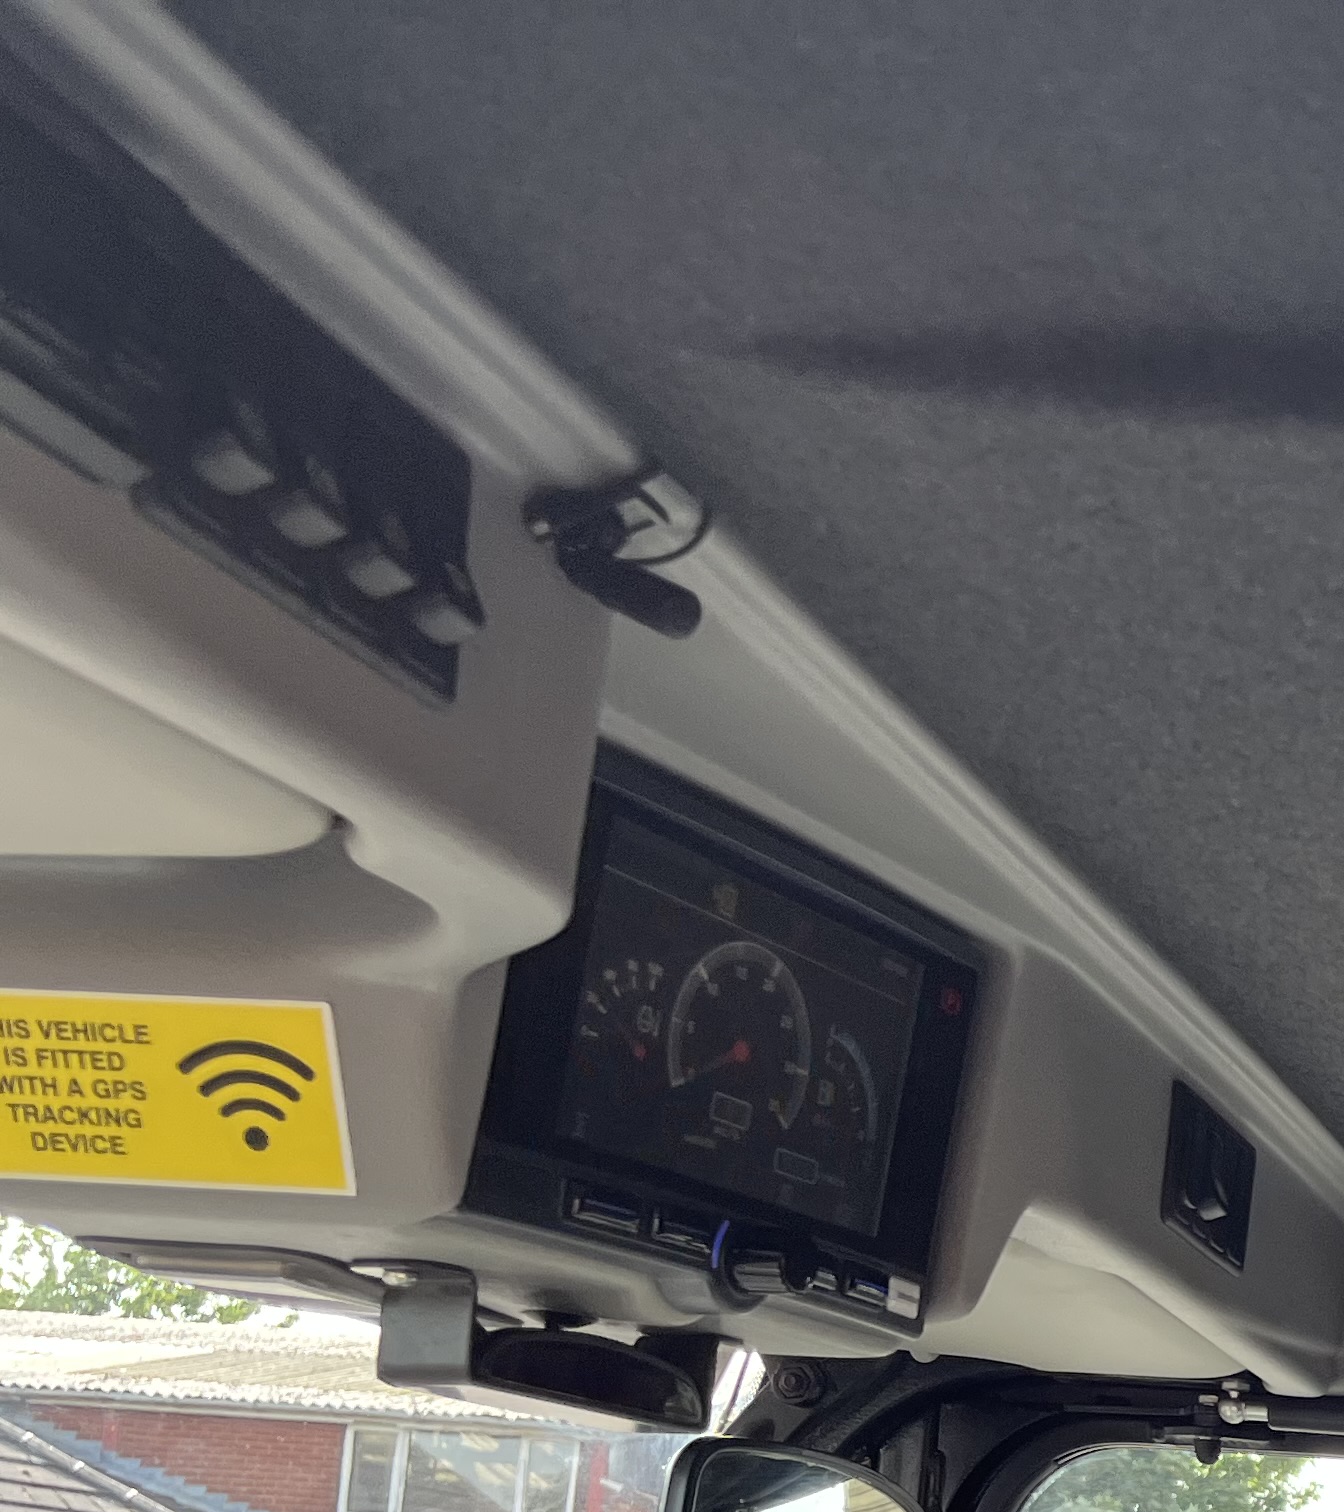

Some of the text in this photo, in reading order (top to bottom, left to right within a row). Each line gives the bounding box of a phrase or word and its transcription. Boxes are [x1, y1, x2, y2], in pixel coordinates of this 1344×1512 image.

[0, 1019, 152, 1044] IS VEHICLE
[3, 1046, 126, 1071] IS FITTED
[67, 1078, 84, 1097] A
[92, 1079, 147, 1101] GPS
[6, 1103, 143, 1129] TRACKING
[30, 1131, 128, 1156] DEVICE
